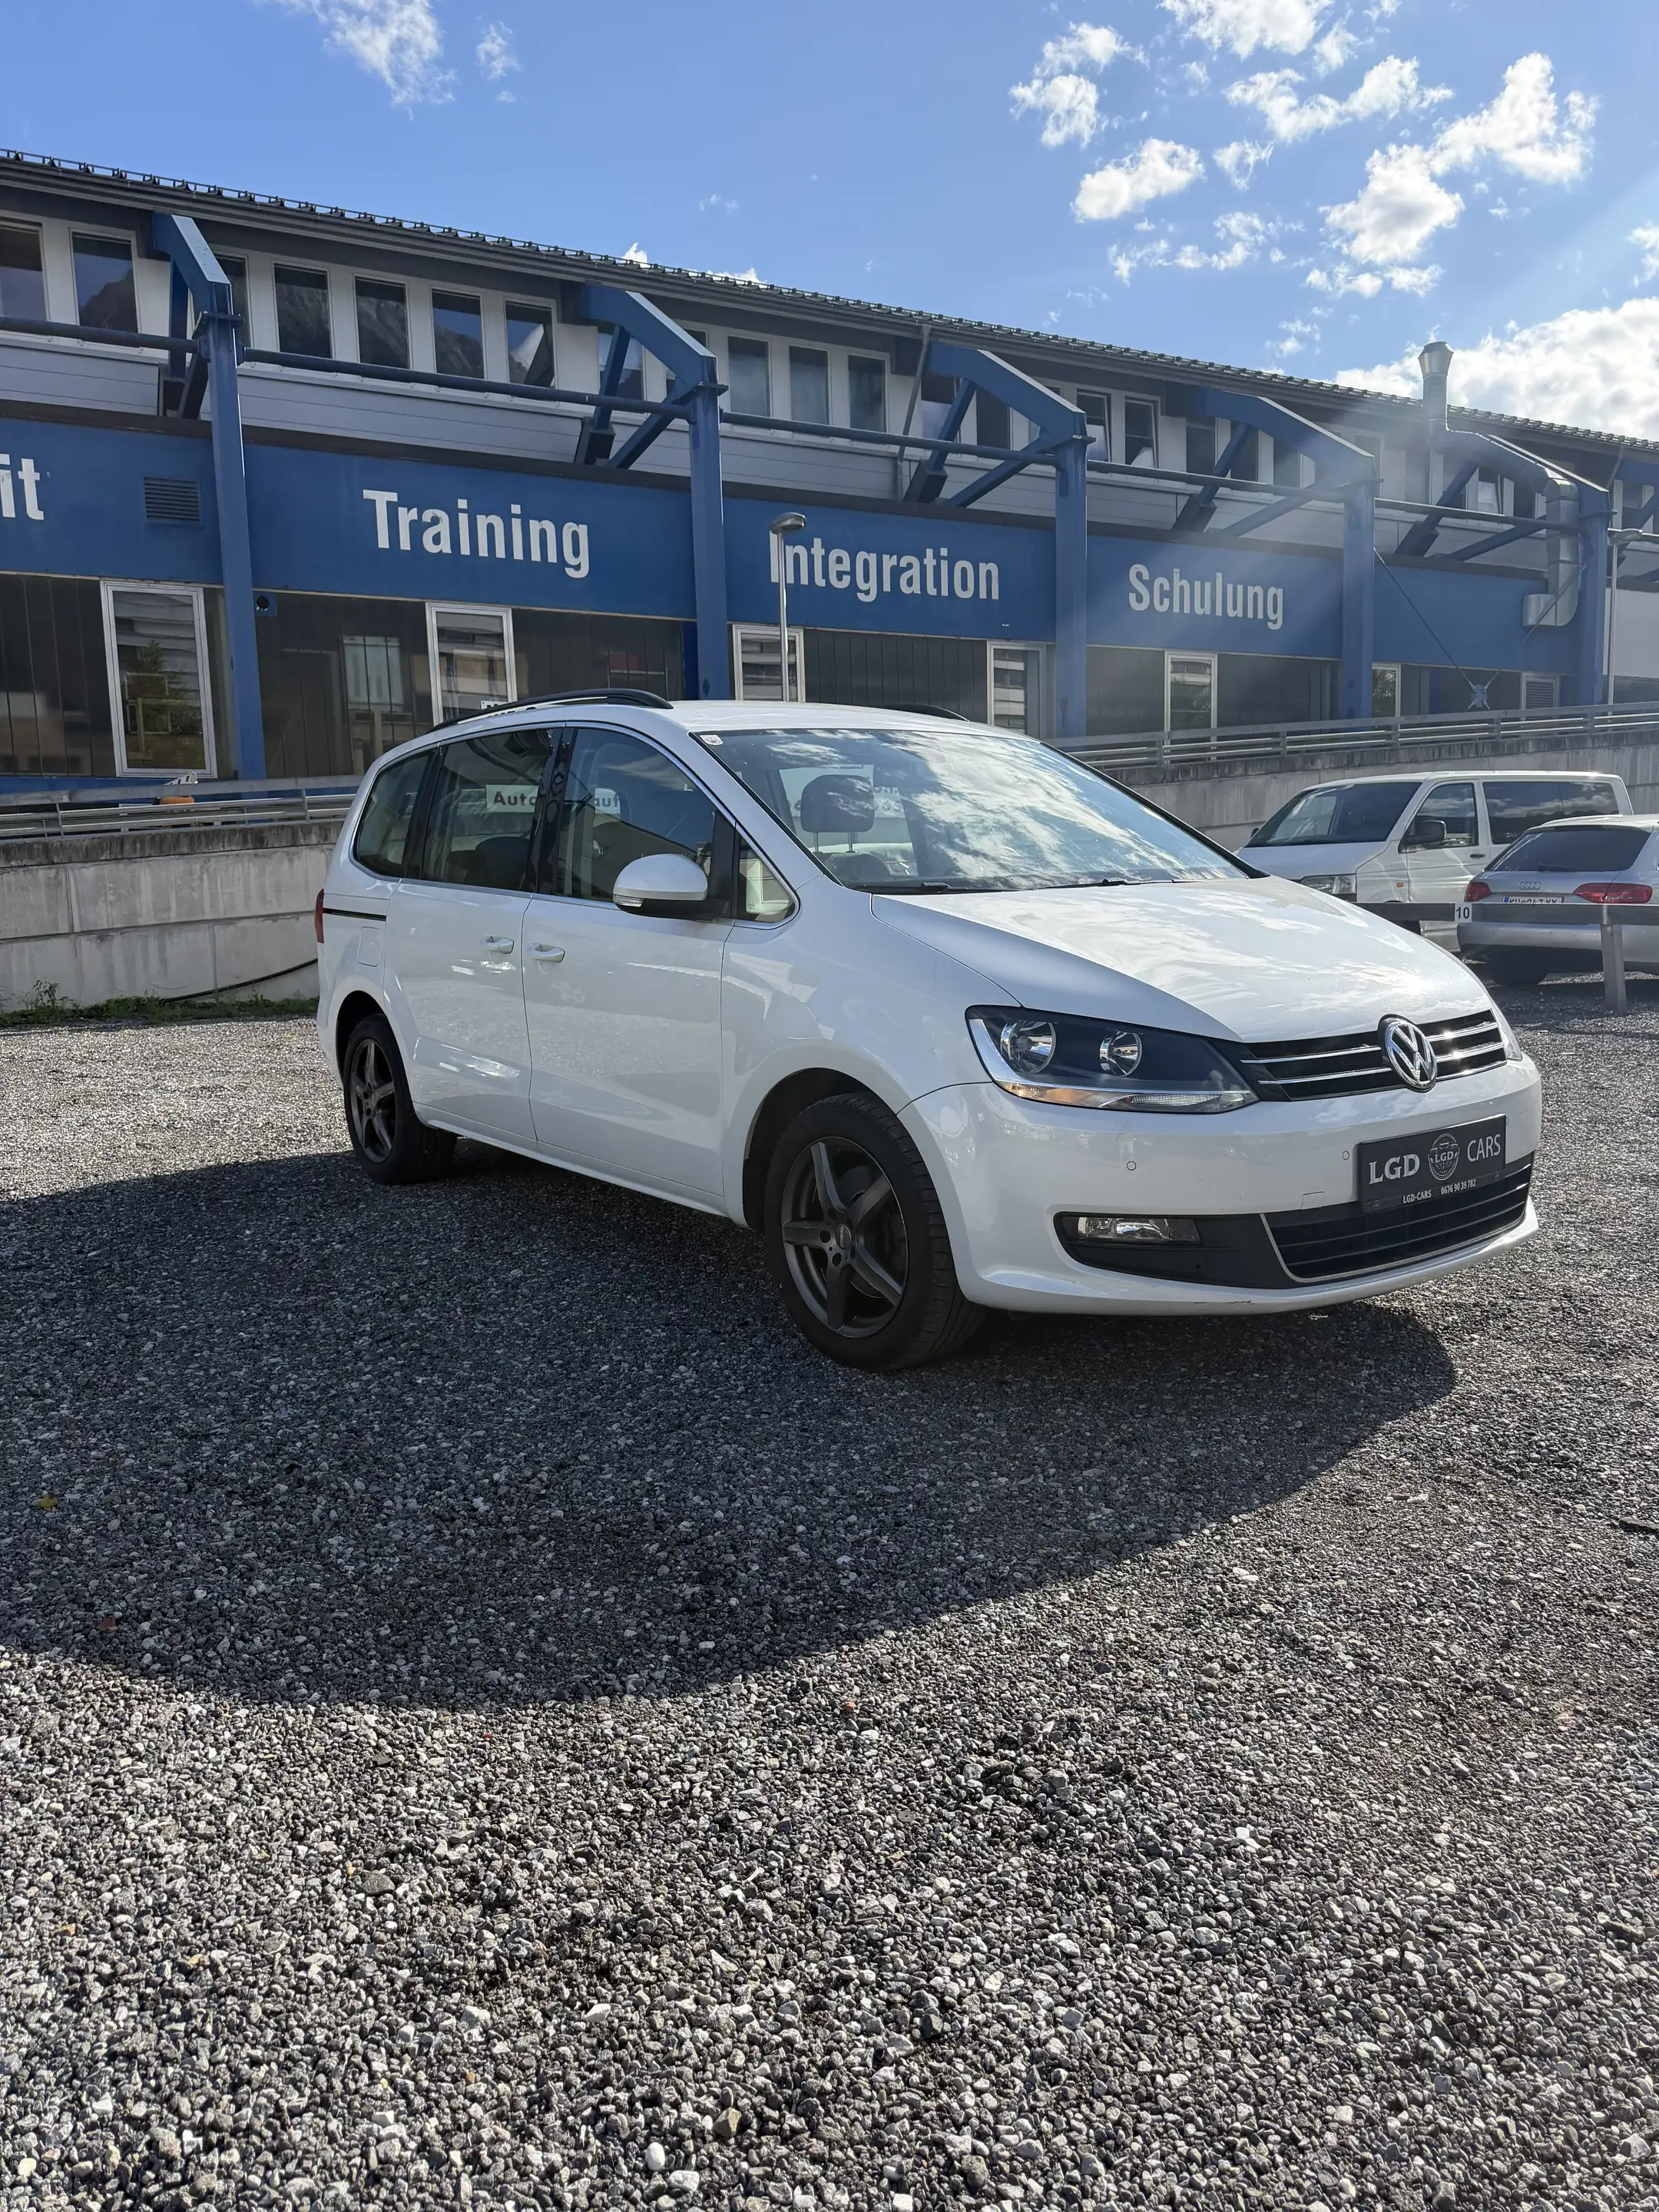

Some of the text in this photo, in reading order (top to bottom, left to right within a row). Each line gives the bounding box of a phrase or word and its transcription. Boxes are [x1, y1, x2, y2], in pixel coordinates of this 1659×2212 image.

[363, 489, 590, 578] Training
[769, 530, 999, 603] Integration
[1128, 564, 1283, 630] Schulung
[1455, 906, 1470, 919] 10
[1369, 1134, 1502, 1185] LGD CARS
[1434, 1151, 1454, 1164] LGD
[1402, 1179, 1476, 1204] LGD-CARS 0676 90 39 782
